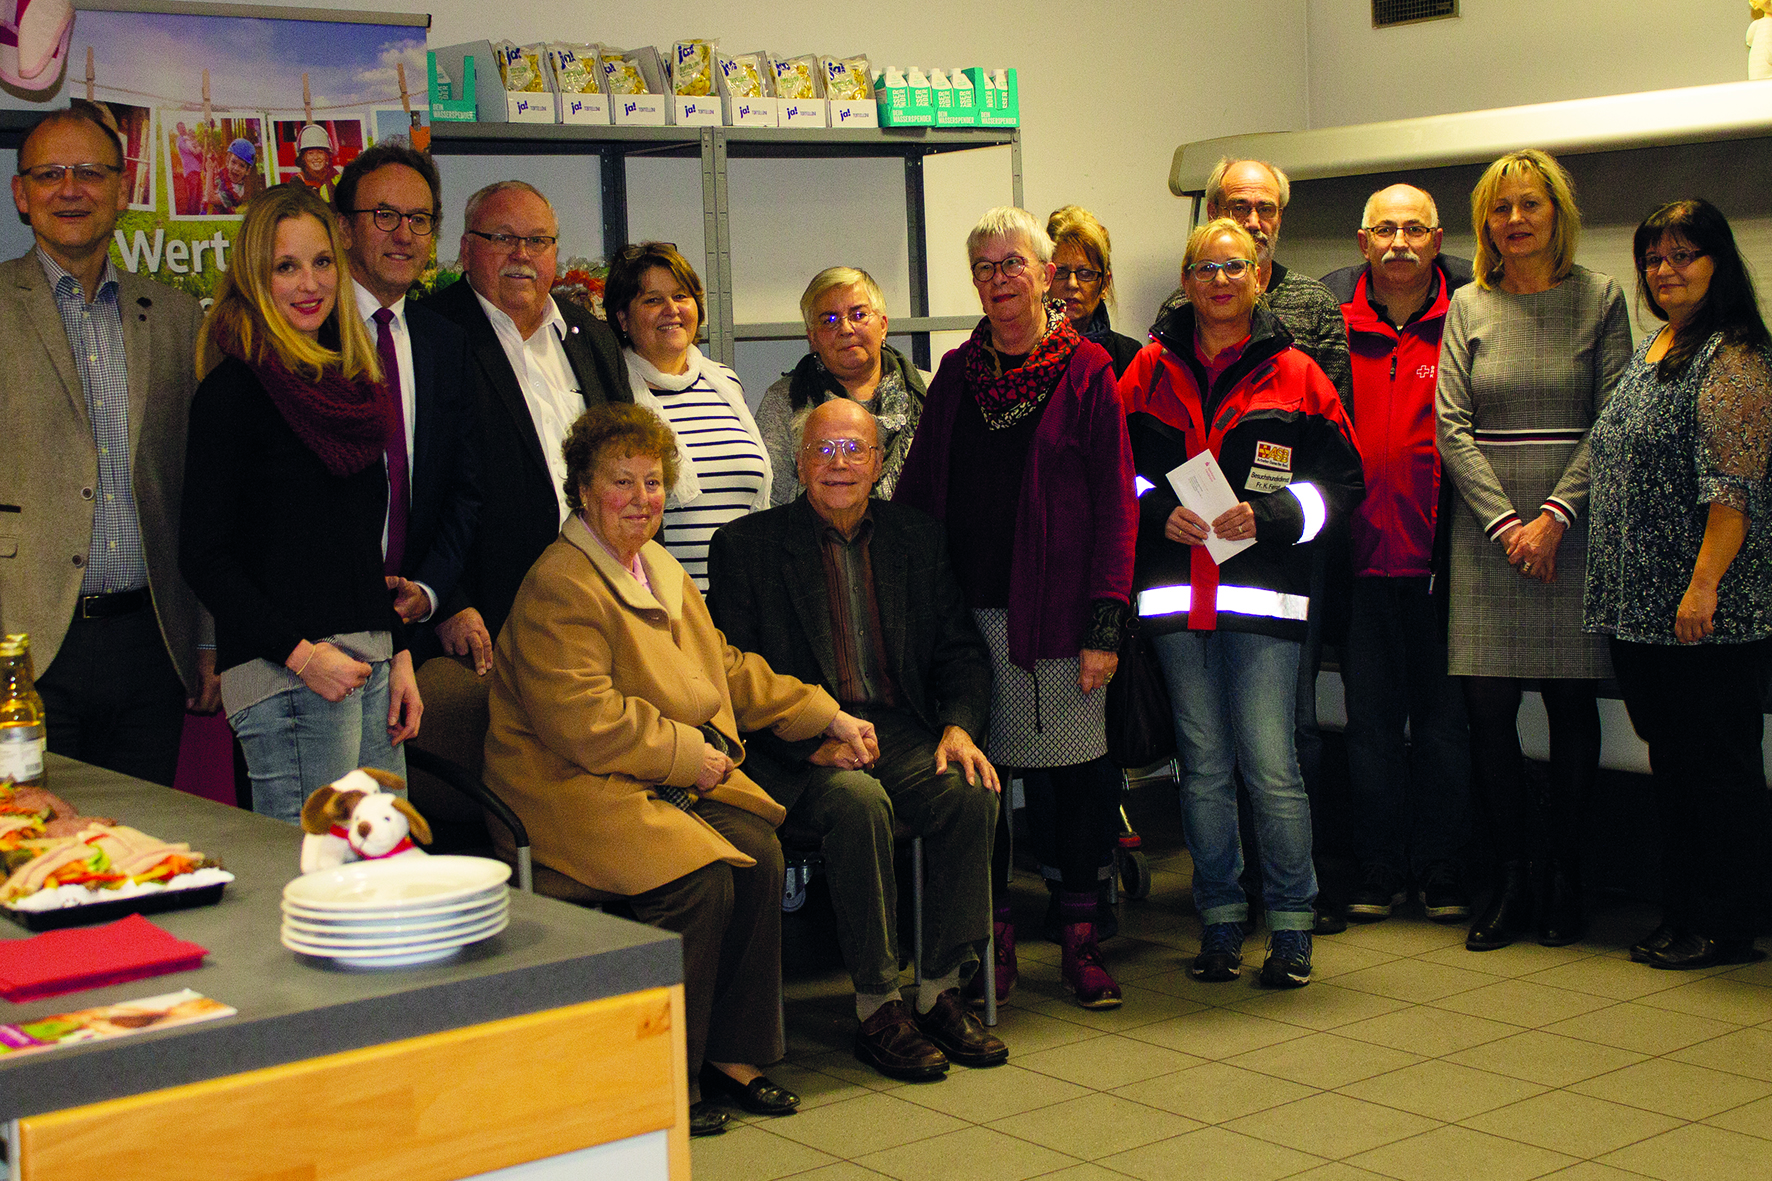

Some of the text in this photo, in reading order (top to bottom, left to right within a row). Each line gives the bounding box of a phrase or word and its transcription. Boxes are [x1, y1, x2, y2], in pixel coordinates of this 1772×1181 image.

[517, 100, 529, 114] ja!
[571, 101, 583, 115] ja!
[624, 102, 637, 116] ja!
[684, 104, 696, 118] ja!
[739, 105, 750, 119] ja!
[786, 106, 798, 120] ja!
[840, 108, 851, 122] ja!
[114, 228, 230, 273] Wert
[1267, 447, 1289, 463] ASB
